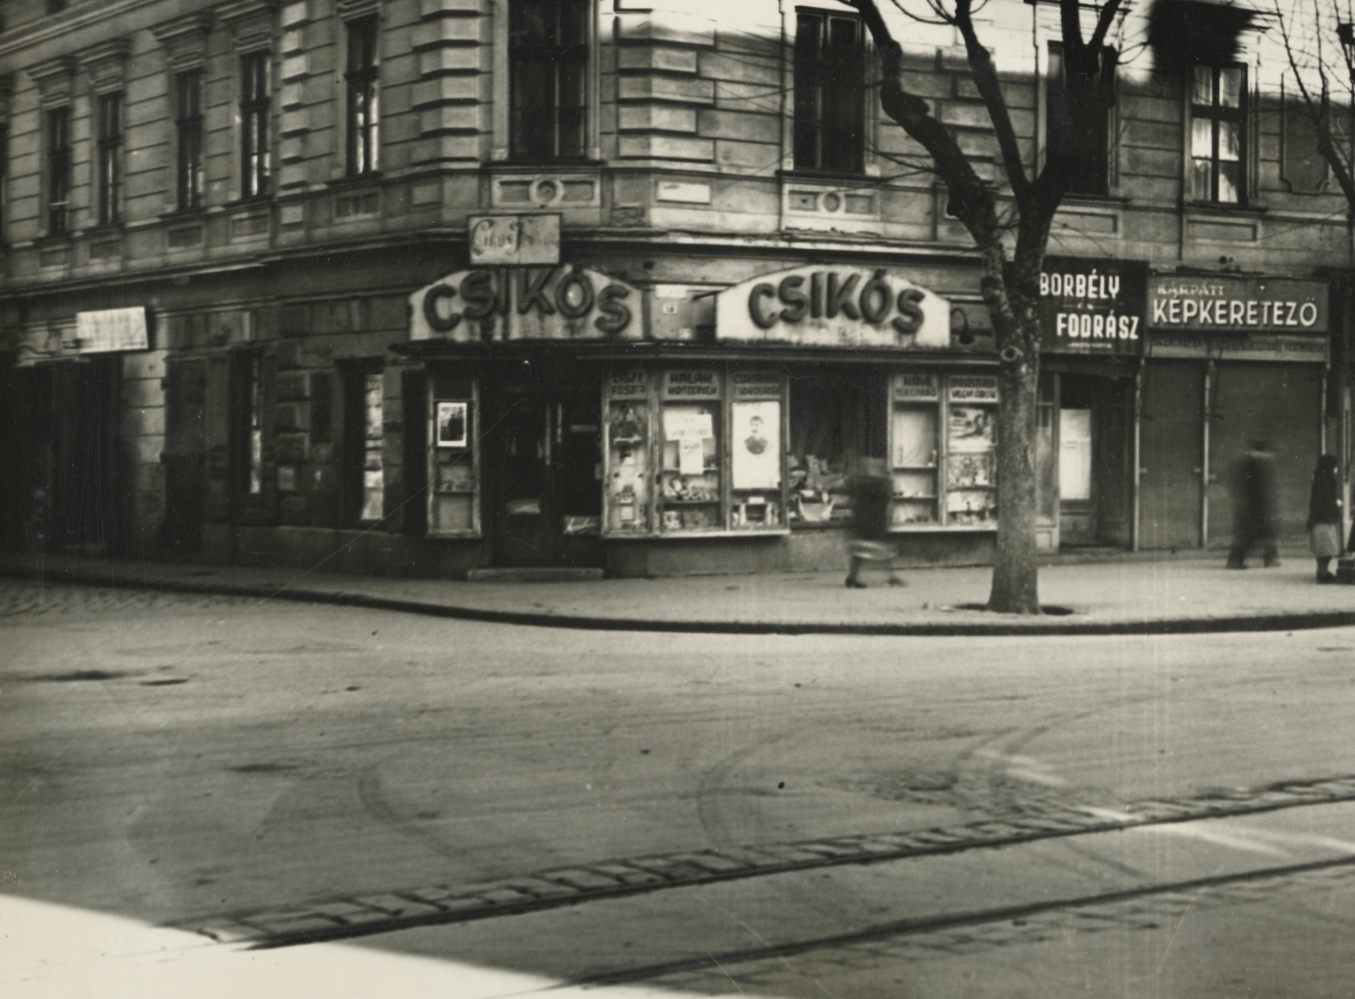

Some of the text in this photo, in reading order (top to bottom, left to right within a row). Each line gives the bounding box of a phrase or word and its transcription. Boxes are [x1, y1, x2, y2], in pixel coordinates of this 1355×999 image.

[424, 265, 632, 333] CSIKÓS
[748, 268, 926, 334] CSIKÓS
[1039, 268, 1120, 300] BORBÉLY
[1056, 309, 1139, 340] FODRÁSZ
